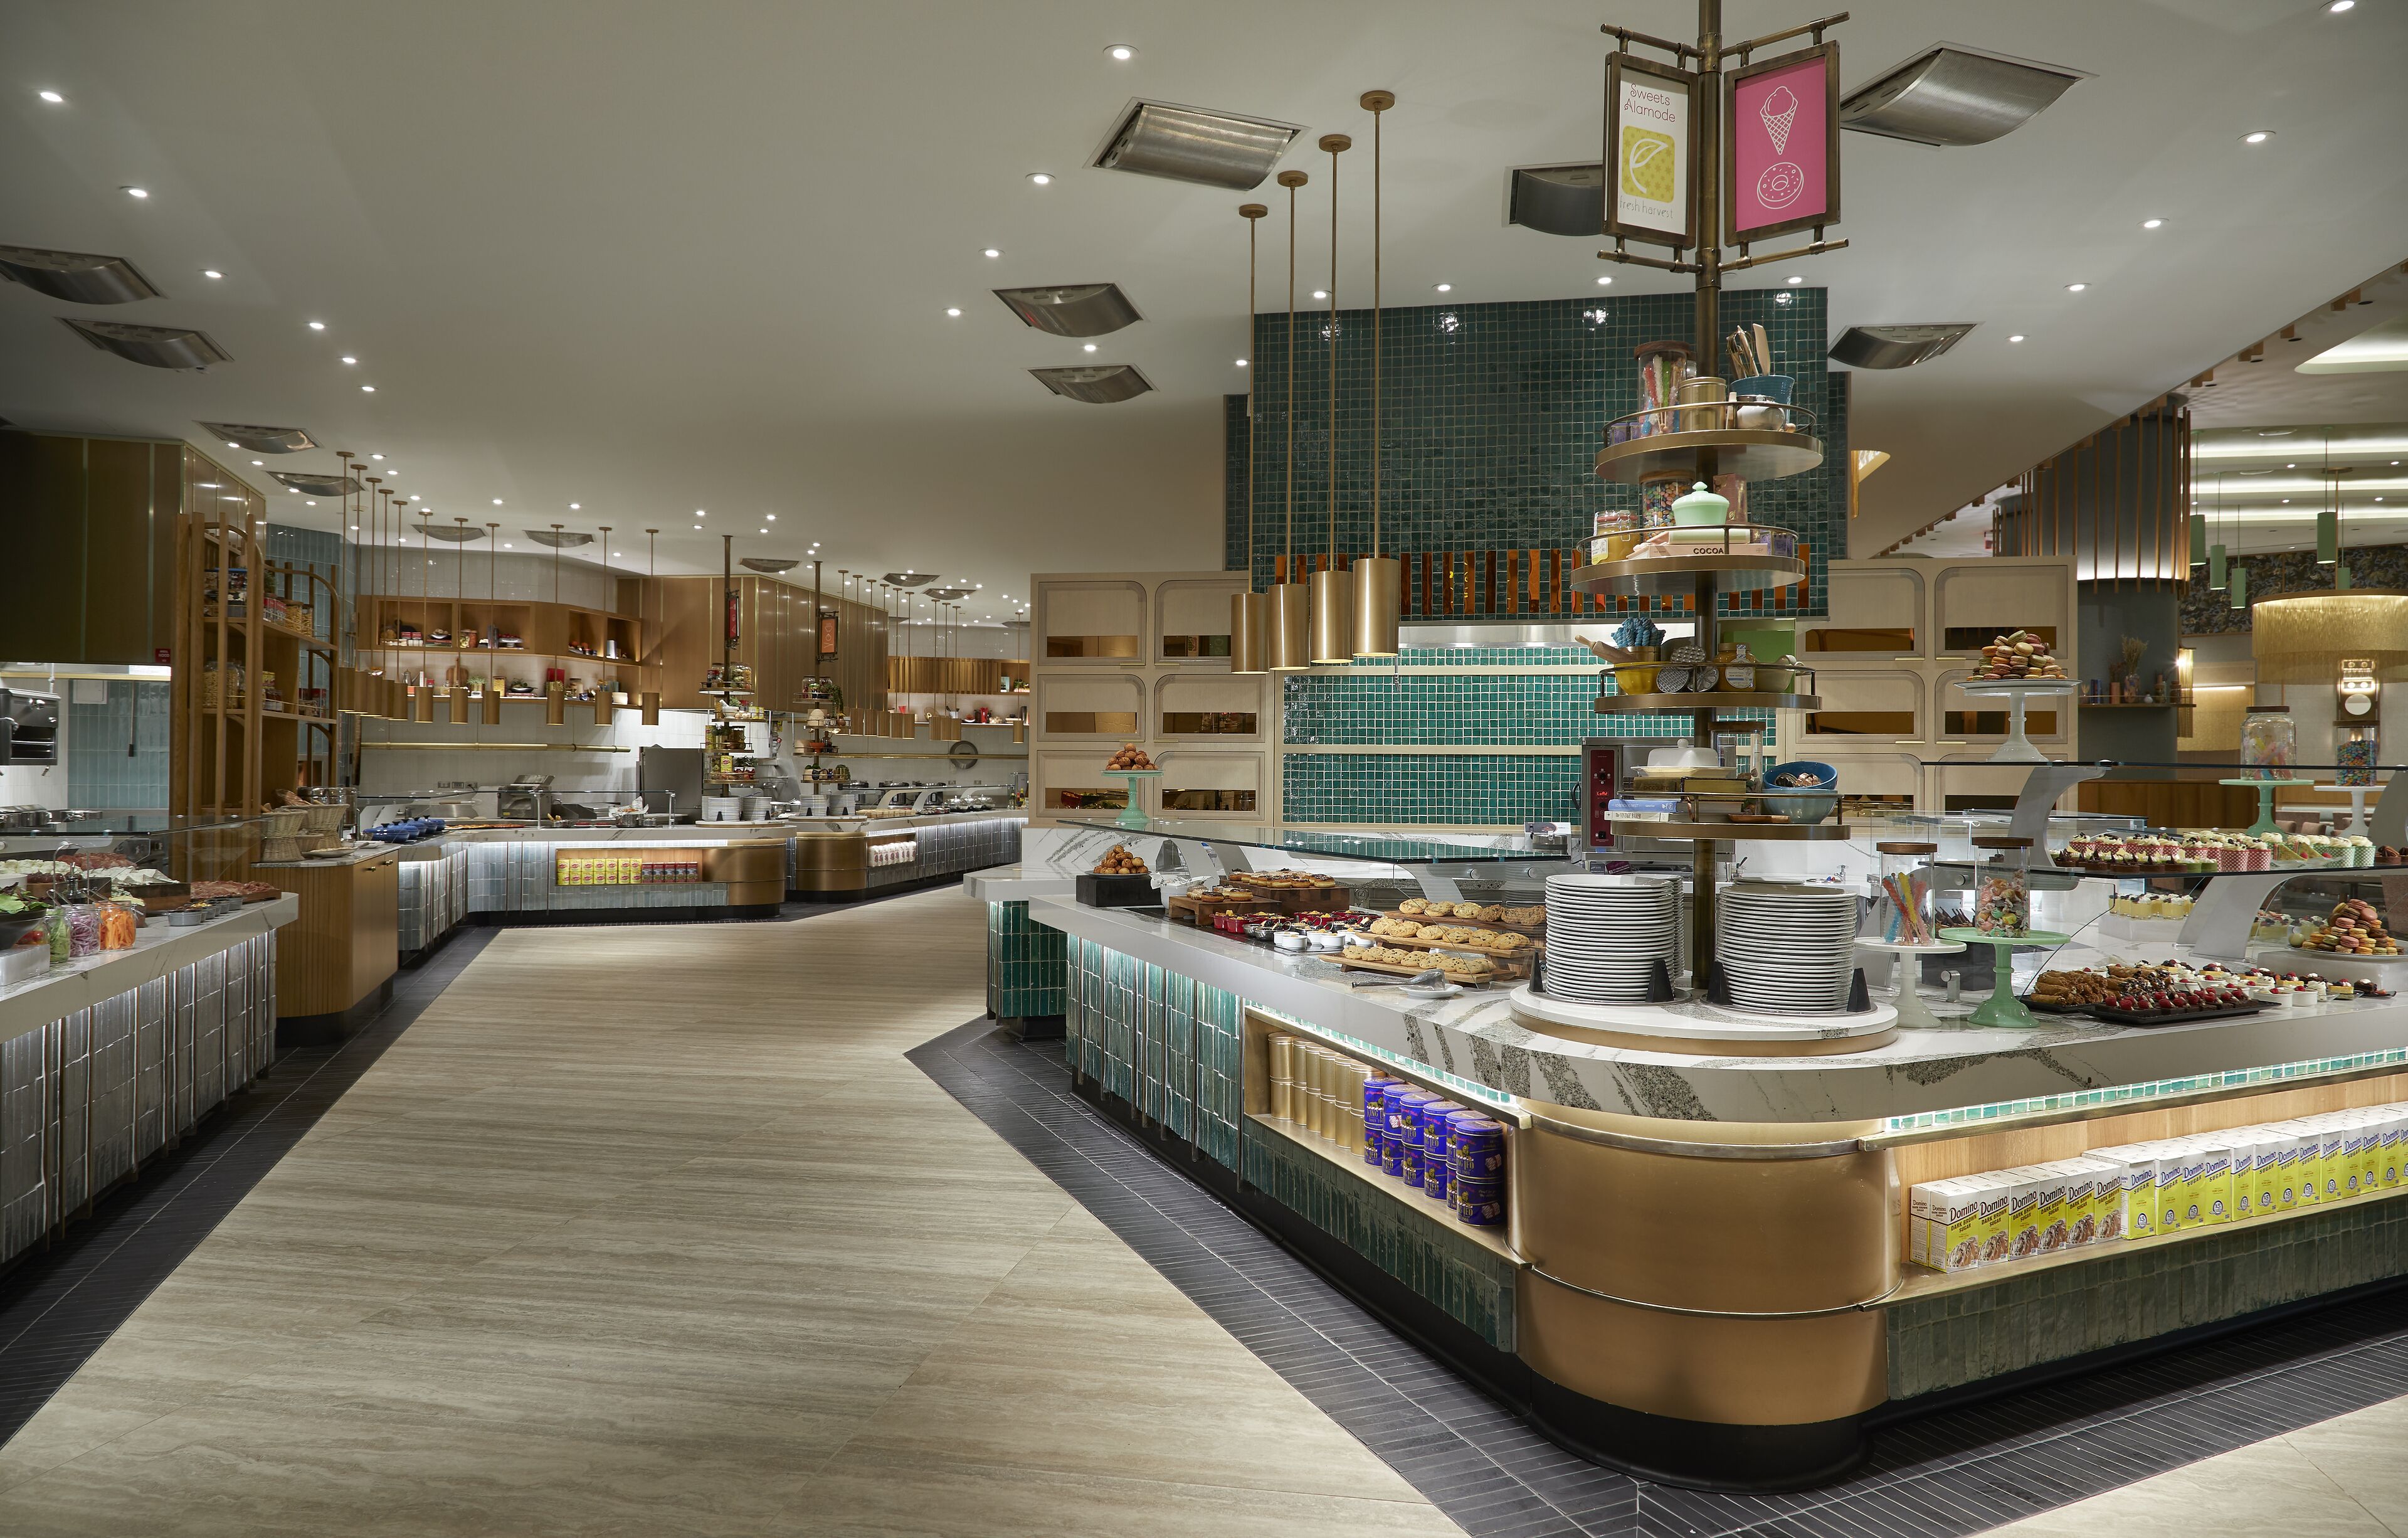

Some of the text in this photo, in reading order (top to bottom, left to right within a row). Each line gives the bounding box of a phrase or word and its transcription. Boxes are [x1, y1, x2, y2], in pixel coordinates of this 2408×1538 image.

[1630, 83, 1671, 106] Sweets
[1624, 98, 1676, 122] Alamode
[1620, 195, 1674, 219] fresh harvest
[2363, 1133, 2379, 1147] Domino
[2383, 1129, 2399, 1143] Domino
[2300, 1144, 2318, 1158] Domino
[2323, 1140, 2340, 1154] Domino
[2346, 1137, 2362, 1152] Domino
[2365, 1144, 2378, 1155] SUGAR
[2385, 1140, 2398, 1151] SUGAR
[2257, 1152, 2276, 1167] Domino
[2278, 1148, 2296, 1163] Domino
[2302, 1155, 2315, 1165] SUGAR
[2325, 1151, 2338, 1162] SUGAR
[2348, 1148, 2360, 1159] SUGAR
[2206, 1159, 2227, 1173] Domino
[2236, 1154, 2251, 1170] Domino
[2260, 1164, 2274, 1174] SUGAR
[2281, 1160, 2295, 1170] SUGAR
[2131, 1170, 2152, 1185] Domino
[2162, 1167, 2180, 1183] Domino
[2184, 1163, 2204, 1178] Domino
[2209, 1170, 2225, 1182] SUGAR
[2238, 1167, 2250, 1178] SUGAR
[2097, 1177, 2120, 1196] Domino
[2163, 1179, 2177, 1191] SUGAR
[2187, 1175, 2202, 1187] SUGAR
[2039, 1185, 2064, 1206] Domino
[2069, 1180, 2092, 1201] Domino
[2133, 1183, 2149, 1194] SUGAR
[2011, 1191, 2037, 1211] Domino
[2070, 1193, 2092, 1209] DARK BROWN
[2098, 1188, 2120, 1204] DARK BROWN
[2105, 1197, 2115, 1206] SUGAR
[1950, 1202, 1978, 1222] Domino
[1980, 1196, 2008, 1216] Domino
[2013, 1203, 2037, 1221] DARK BROWN
[2041, 1198, 2064, 1214] DARK BROWN
[2048, 1207, 2059, 1216] SUGAR
[2077, 1202, 2087, 1211] SUGAR
[1951, 1214, 1977, 1231] DARK BROWN
[1982, 1208, 2007, 1224] DARK BROWN
[1989, 1217, 2002, 1227] SUGAR
[2020, 1212, 2031, 1222] SUGAR
[1959, 1223, 1972, 1233] SUGAR
